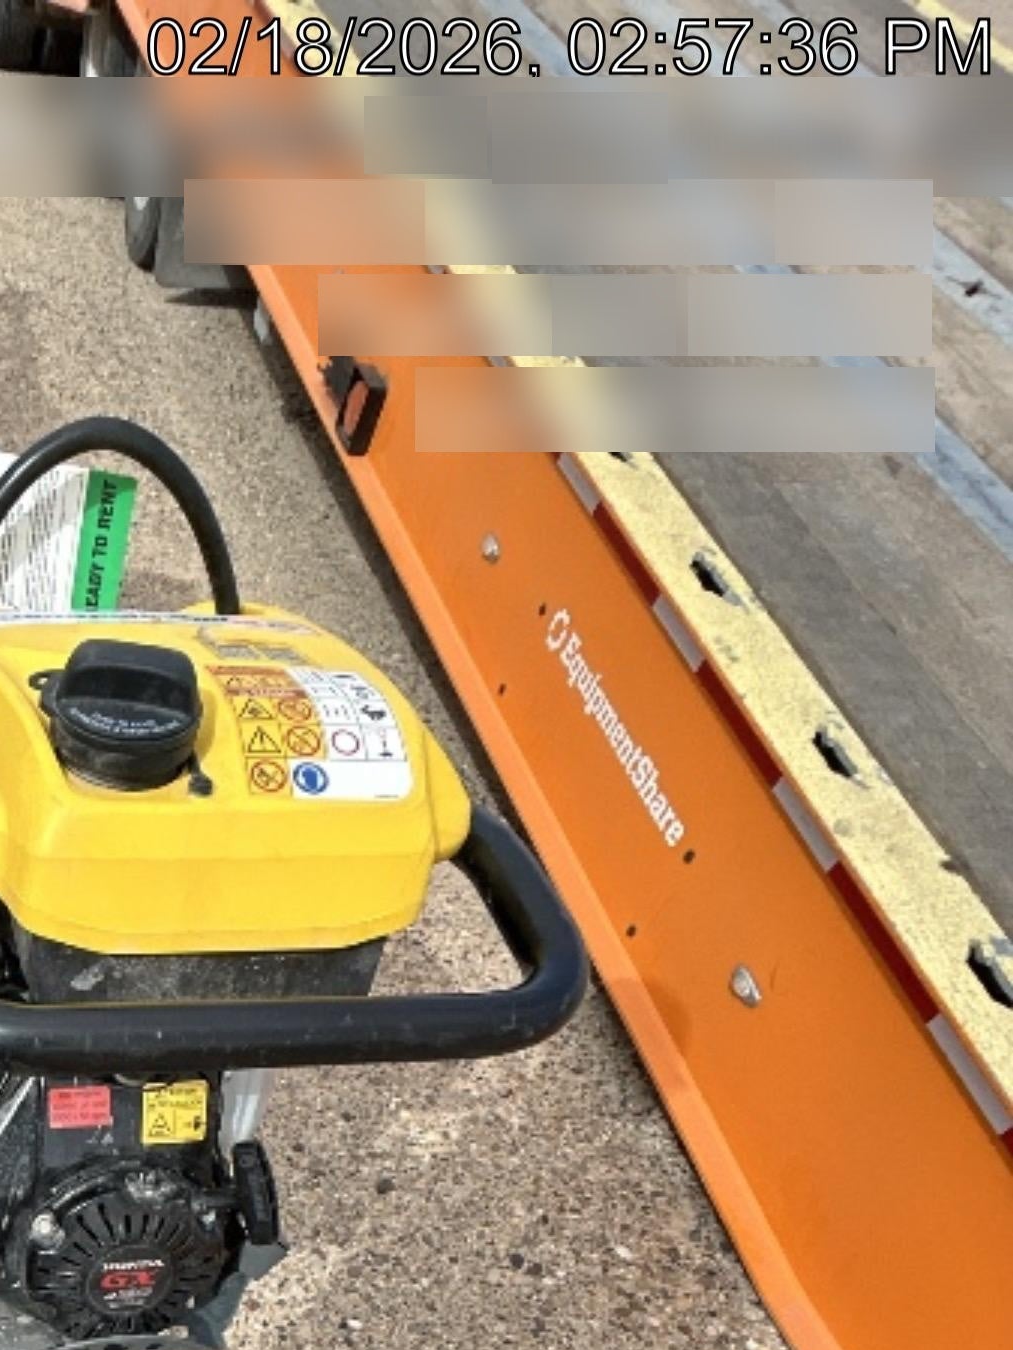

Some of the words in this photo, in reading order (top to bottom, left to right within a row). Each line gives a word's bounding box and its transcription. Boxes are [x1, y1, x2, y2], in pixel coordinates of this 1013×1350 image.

[97, 479, 117, 530] RENT
[91, 536, 108, 559] TO
[85, 563, 105, 612] EADY
[560, 632, 685, 847] EquipmentShare
